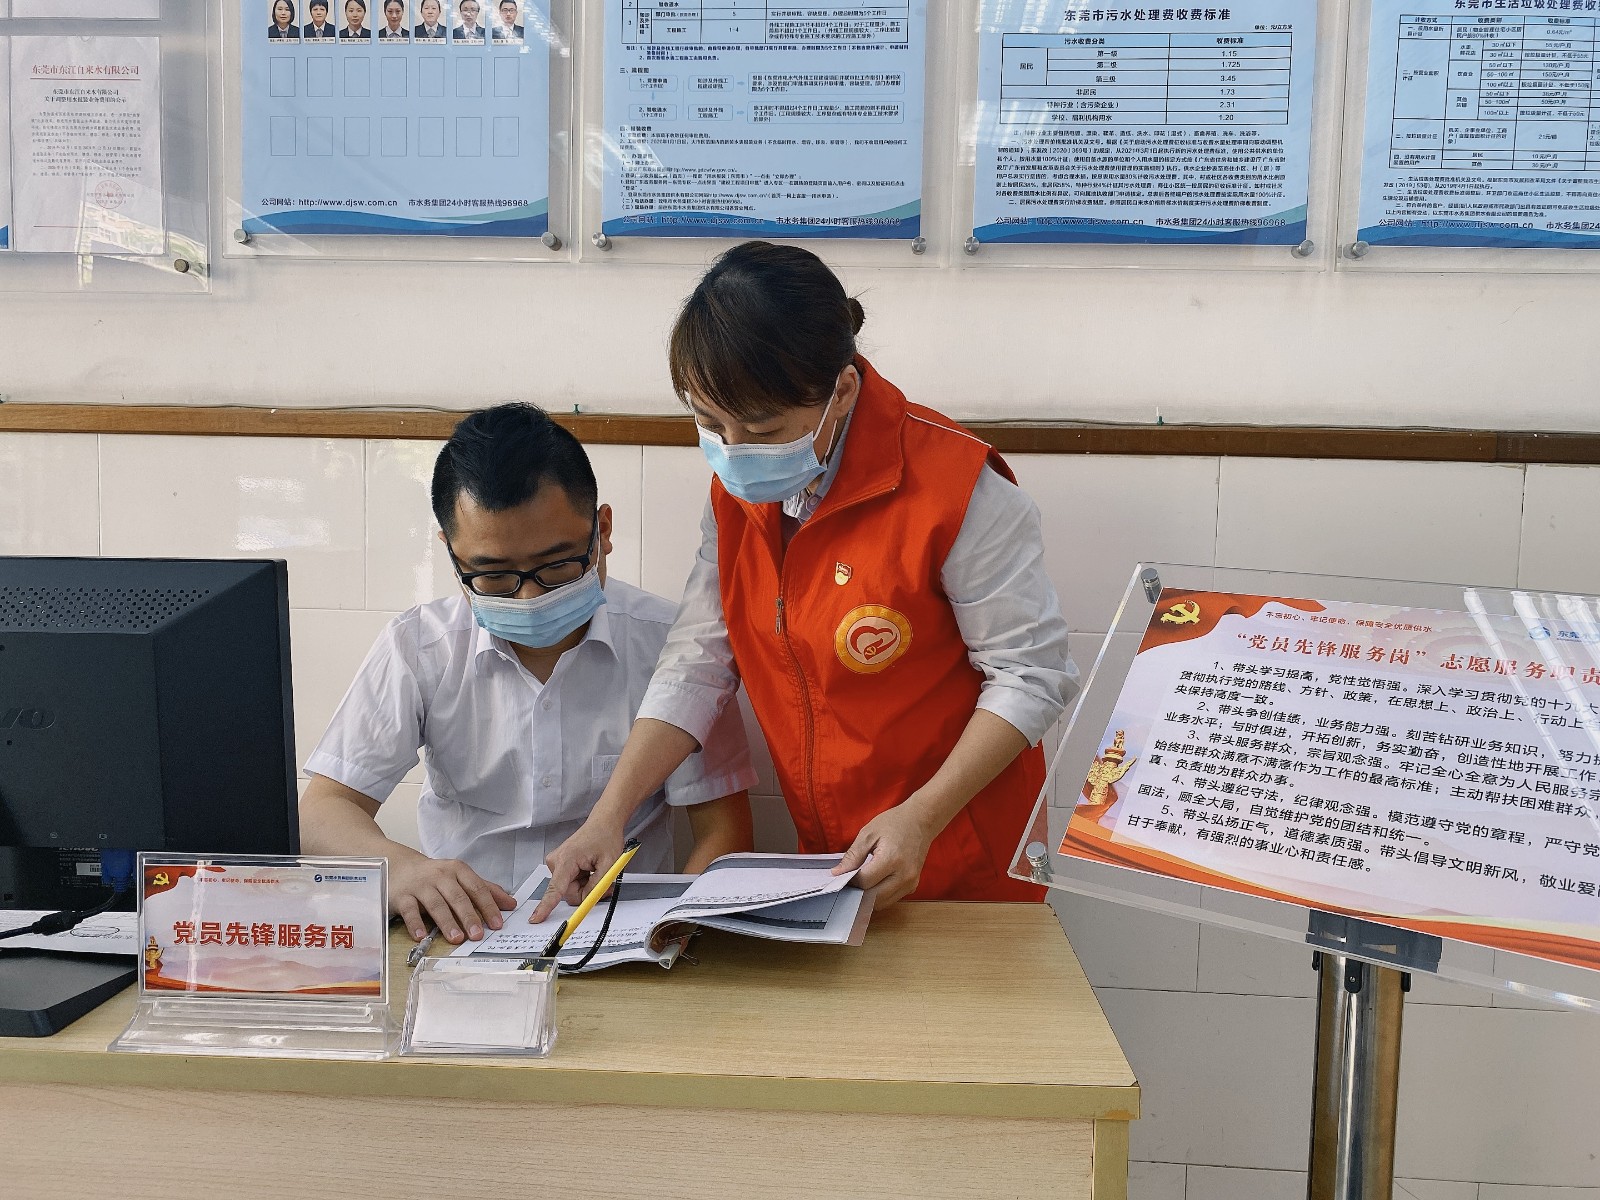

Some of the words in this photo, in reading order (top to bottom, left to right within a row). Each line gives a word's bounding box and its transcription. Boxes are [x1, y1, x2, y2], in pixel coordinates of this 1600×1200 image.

[1454, 0, 1600, 11] 东莞市生活垃圾处理费收
[1064, 9, 1231, 21] 东莞市污水处理费收费标准
[1064, 37, 1105, 45] 污水收费分类
[1216, 37, 1244, 45] 收费标准
[1096, 50, 1118, 58] 第一级
[31, 64, 140, 75] 东莞市东江自来水有限公司
[1020, 62, 1034, 70] 居民
[1096, 61, 1118, 69] 第二级
[1095, 75, 1117, 83] 第三级
[1075, 88, 1097, 96] 非居民
[1046, 100, 1120, 109] 特种行业（含污染企业）
[1052, 114, 1113, 122] 学校、福利机构用水
[408, 199, 529, 207] 市水务集团24小时客服热线96968
[775, 216, 901, 226] 市水务集团24小时客服热线96968
[1155, 217, 1286, 227] 市水务集团24小时客服热线96968
[1174, 684, 1275, 707] 央保持高度一致。
[1148, 754, 1296, 788] 真、负责地为群众办事。
[1137, 783, 1430, 847] 国法，顾全大局，自觉维护党的团结和统一。
[1127, 814, 1372, 872] 甘于奉献，有强烈的事业心和责任感。
[1161, 804, 1600, 898] 5、带头弘扬正气，道德素质强。带头倡导文明新风，敬业爱
[172, 920, 355, 949] 党员先锋服务岗
